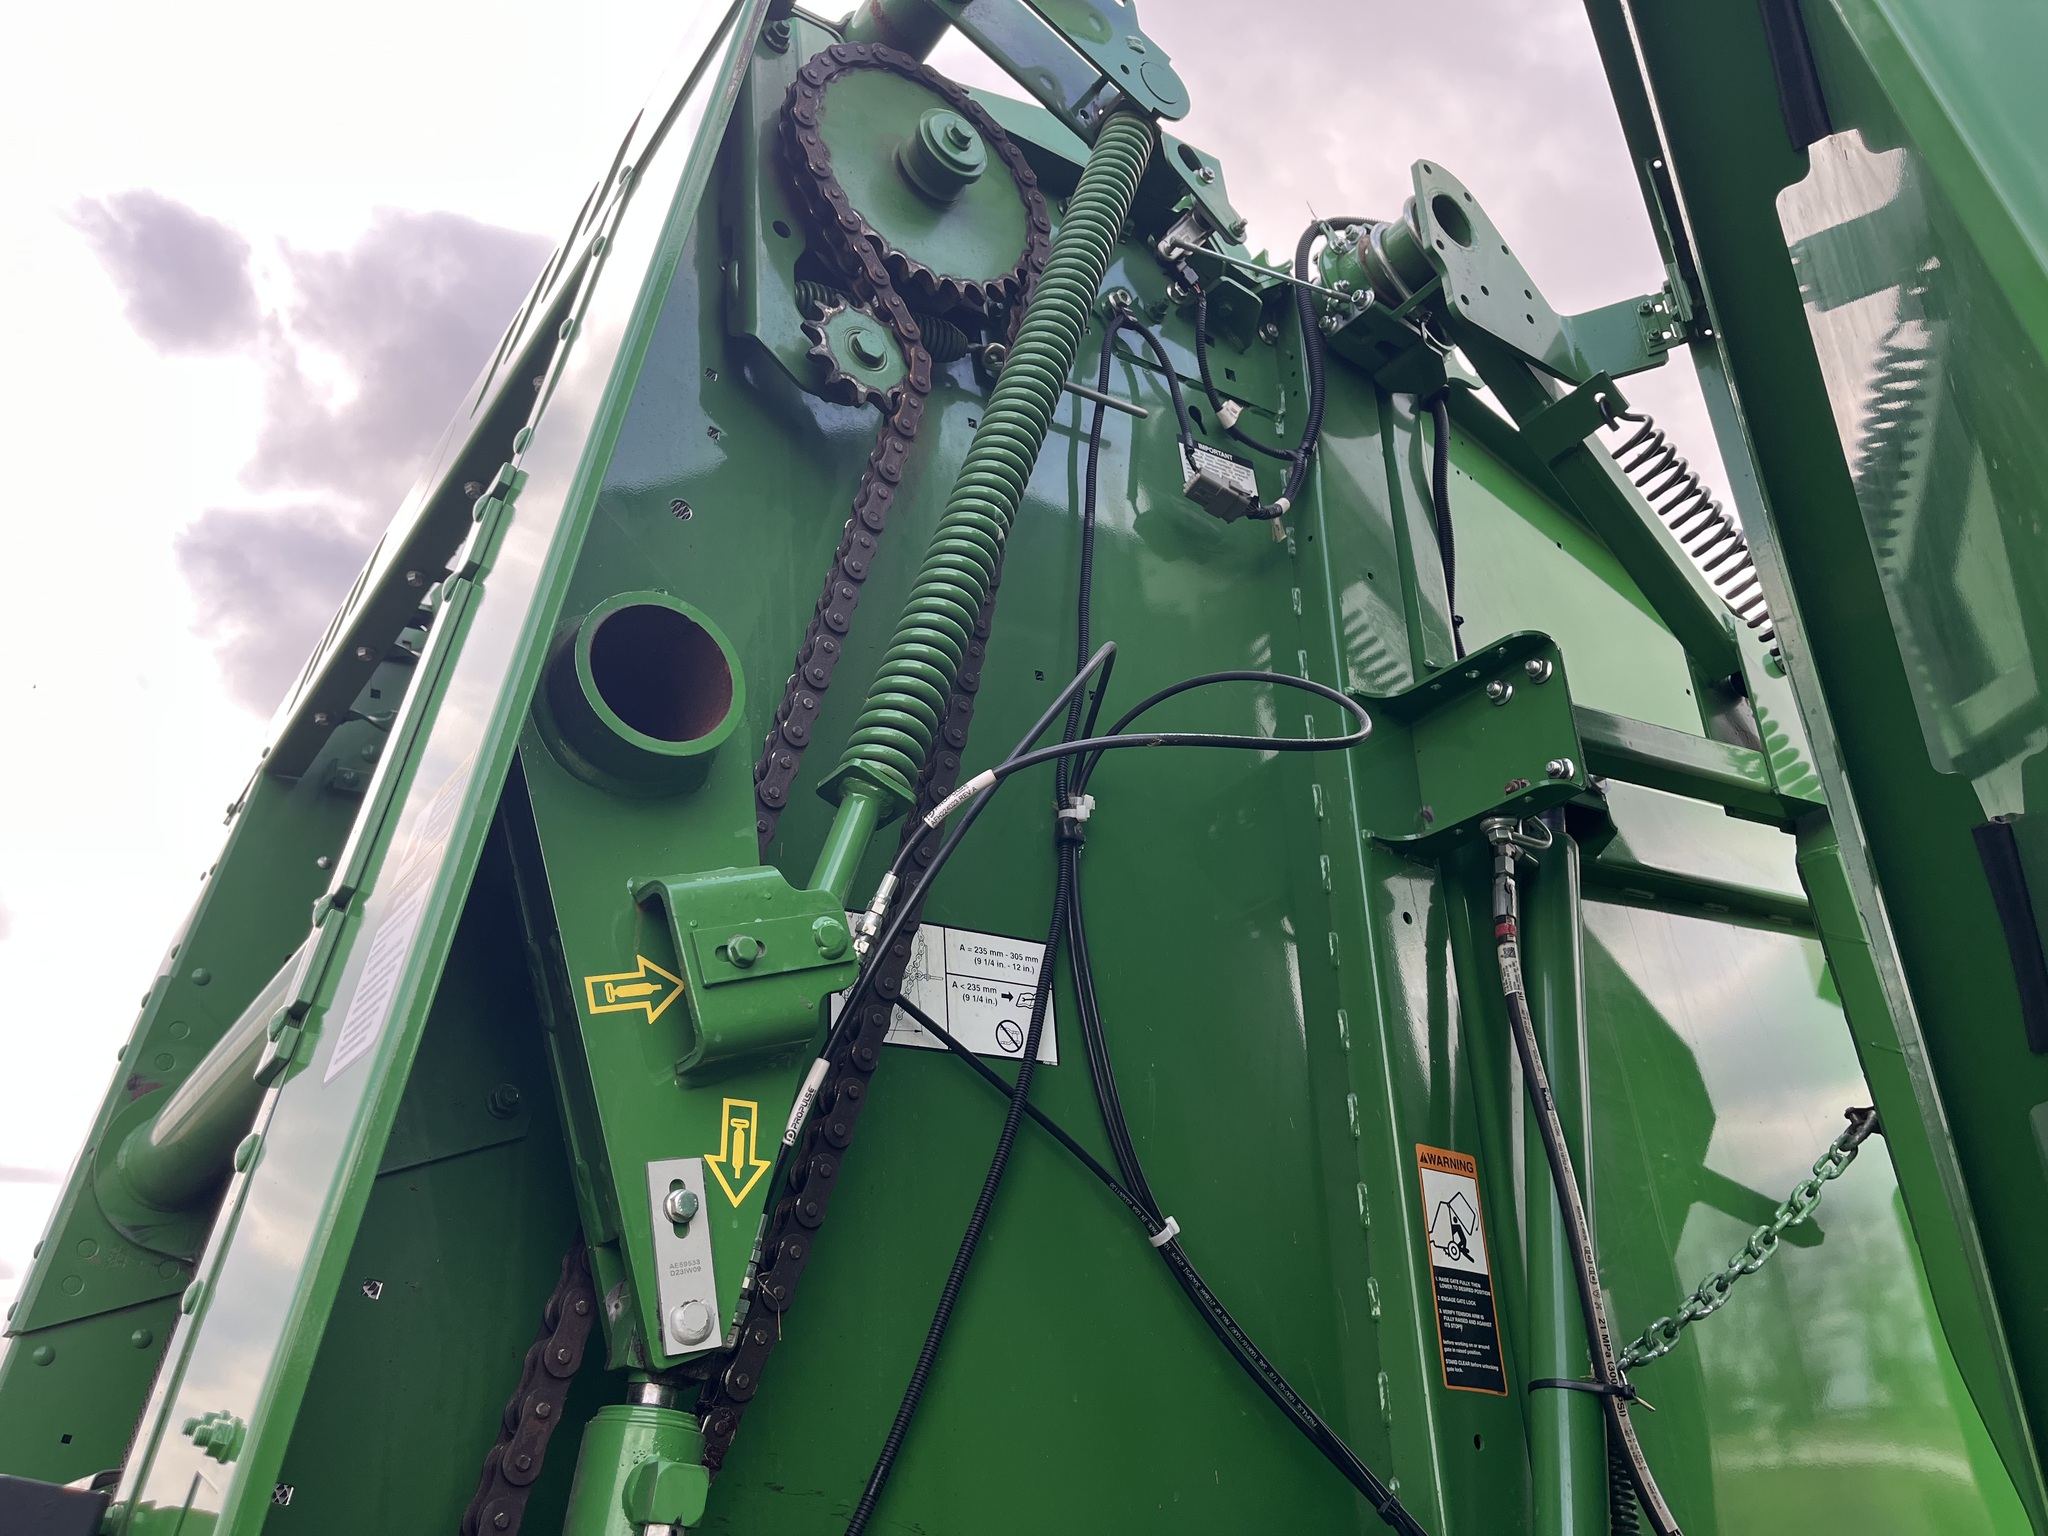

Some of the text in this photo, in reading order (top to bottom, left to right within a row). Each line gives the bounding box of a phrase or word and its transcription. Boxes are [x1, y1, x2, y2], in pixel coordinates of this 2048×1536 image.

[1198, 443, 1233, 460] IMPORTANT
[958, 789, 971, 801] REV
[959, 944, 966, 952] A
[974, 947, 988, 955] 235
[989, 950, 1004, 958] mm
[1010, 952, 1023, 961] 305
[974, 957, 982, 966] (9
[984, 958, 995, 967] 1/4
[996, 960, 1006, 969] in.
[1013, 963, 1020, 971] 12
[1022, 964, 1035, 974] in.)
[967, 983, 981, 992] 235
[963, 994, 998, 1007] (9 1/4 in.)
[790, 1086, 815, 1129] PROPULSE
[1427, 1153, 1474, 1174] WARNING
[1141, 1215, 1148, 1223] IN
[1598, 1316, 1606, 1330] 21
[1600, 1333, 1612, 1358] MPa
